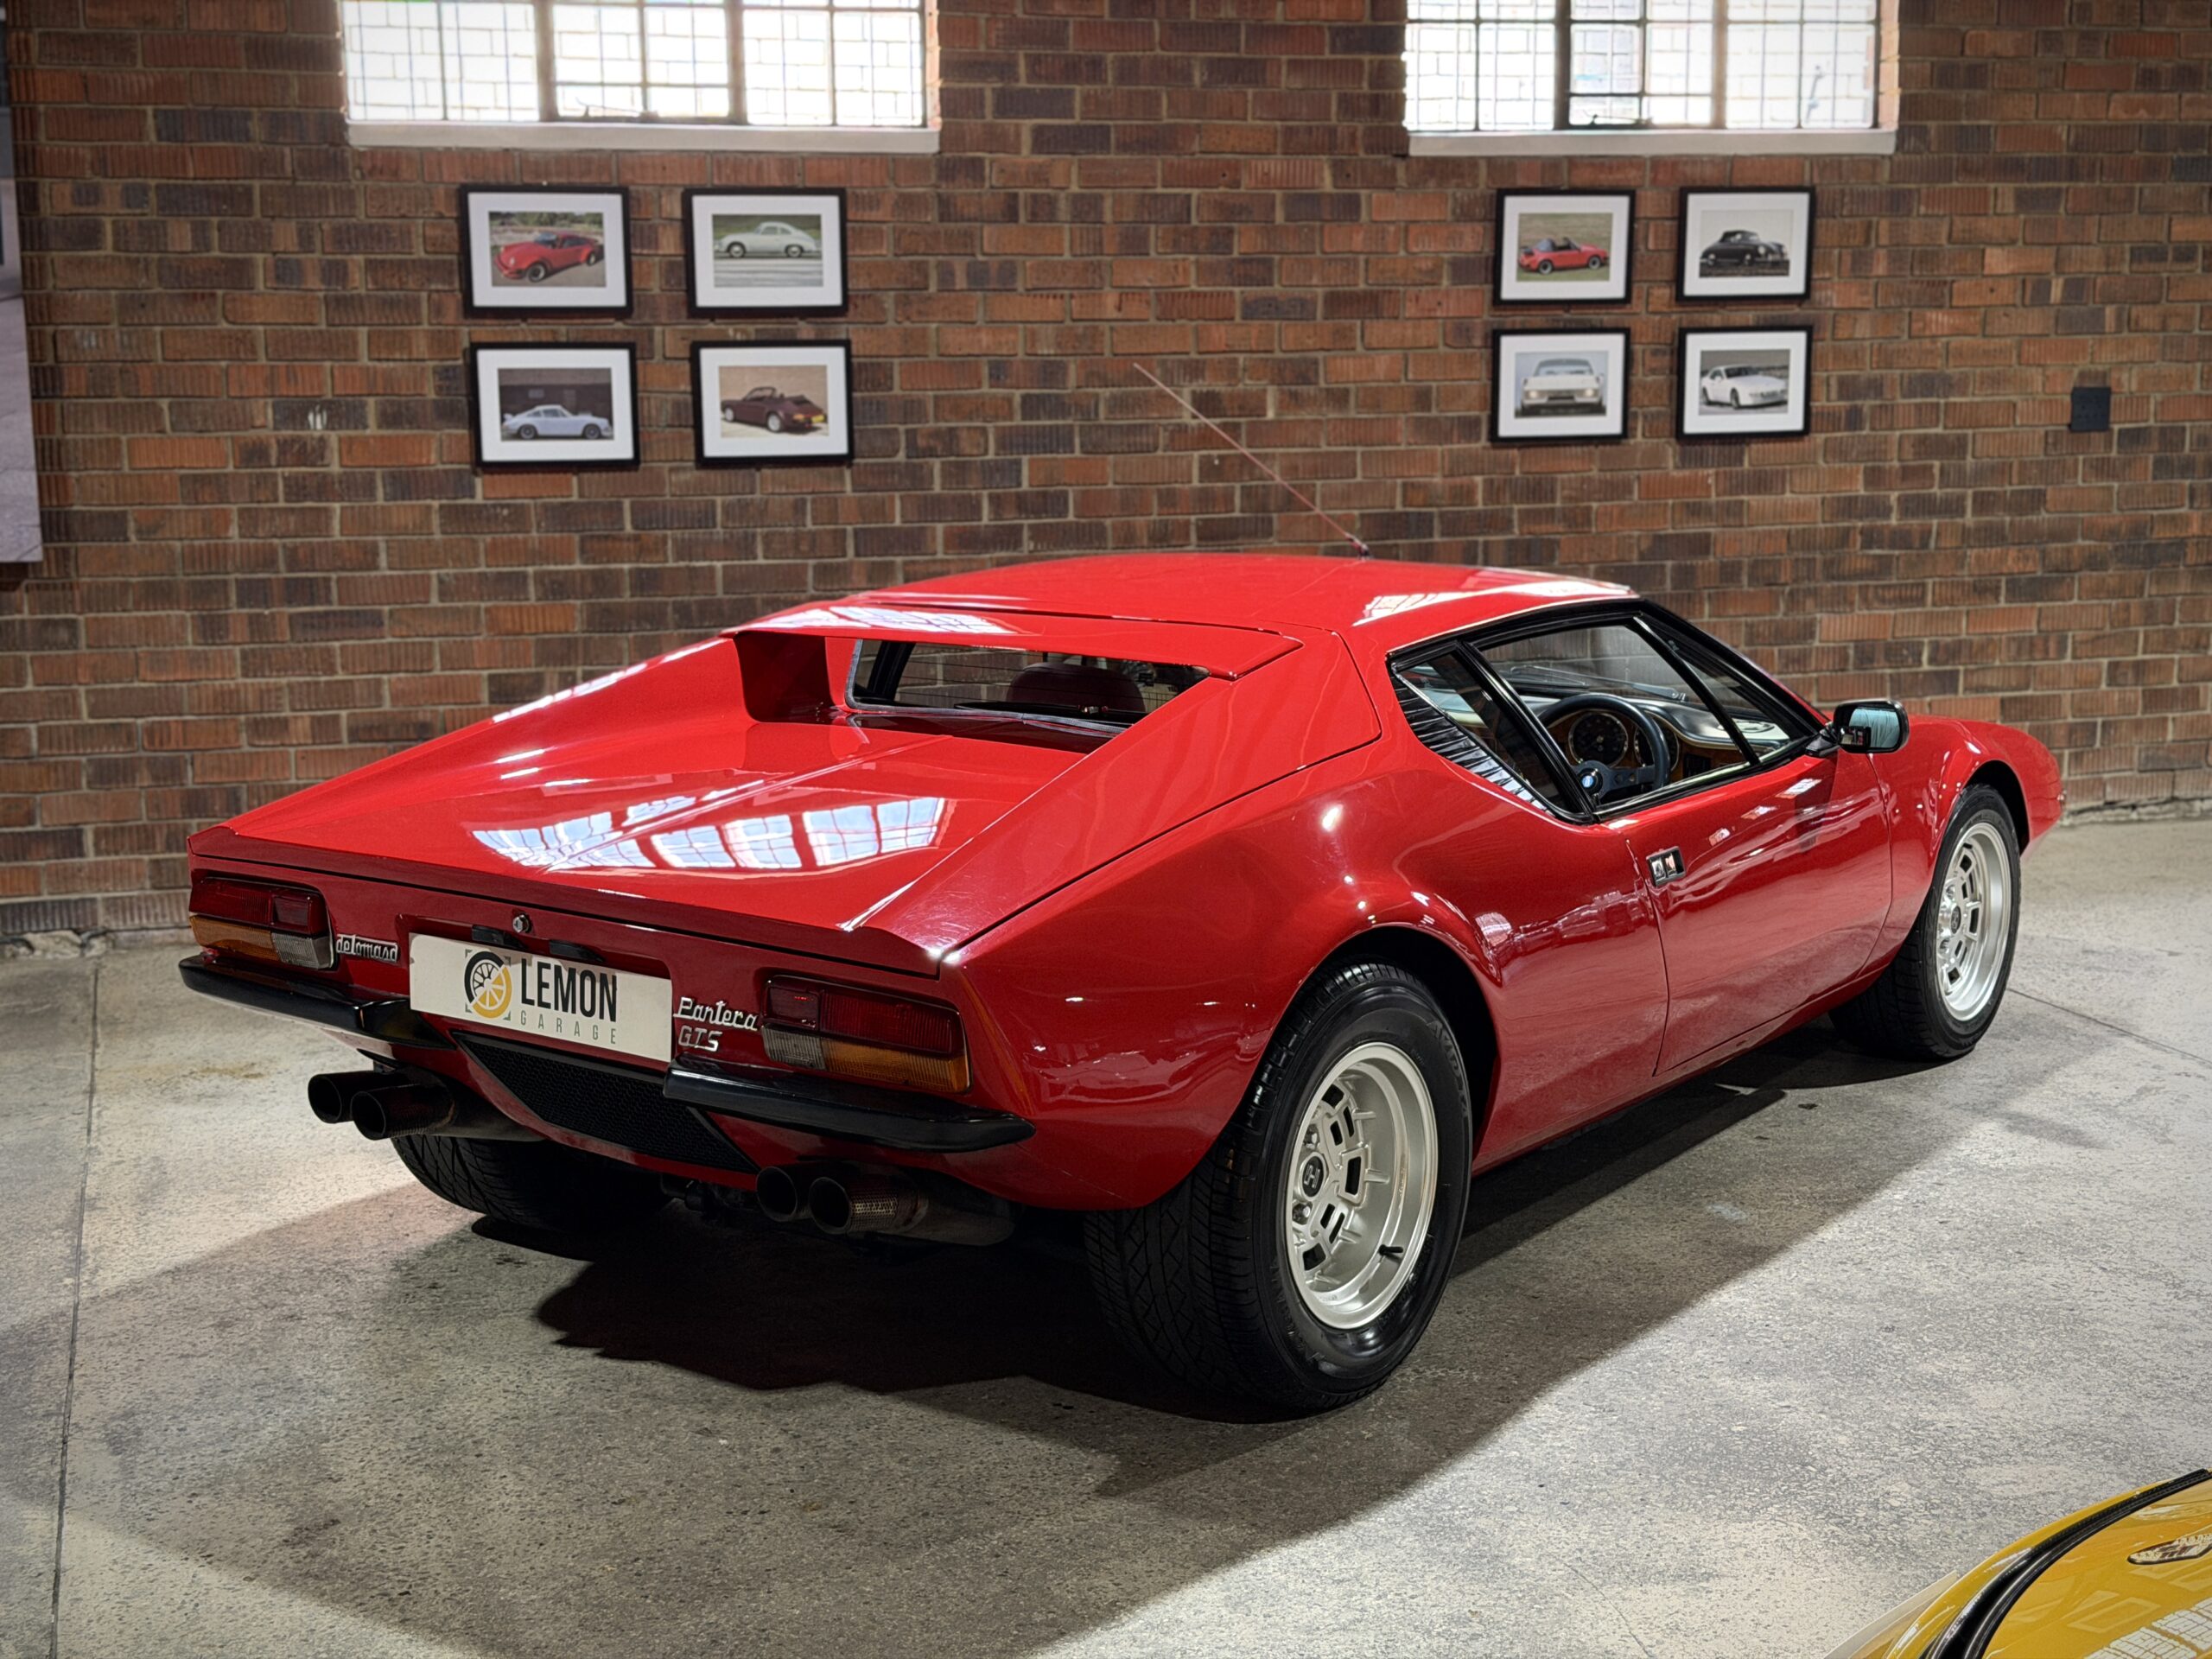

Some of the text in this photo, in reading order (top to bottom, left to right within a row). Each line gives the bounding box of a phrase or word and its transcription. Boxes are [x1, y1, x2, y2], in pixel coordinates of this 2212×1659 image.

[521, 958, 617, 1023] LEMON
[521, 1011, 616, 1045] GARAGE
[673, 996, 758, 1032] Pantera
[678, 1025, 723, 1052] GTS
